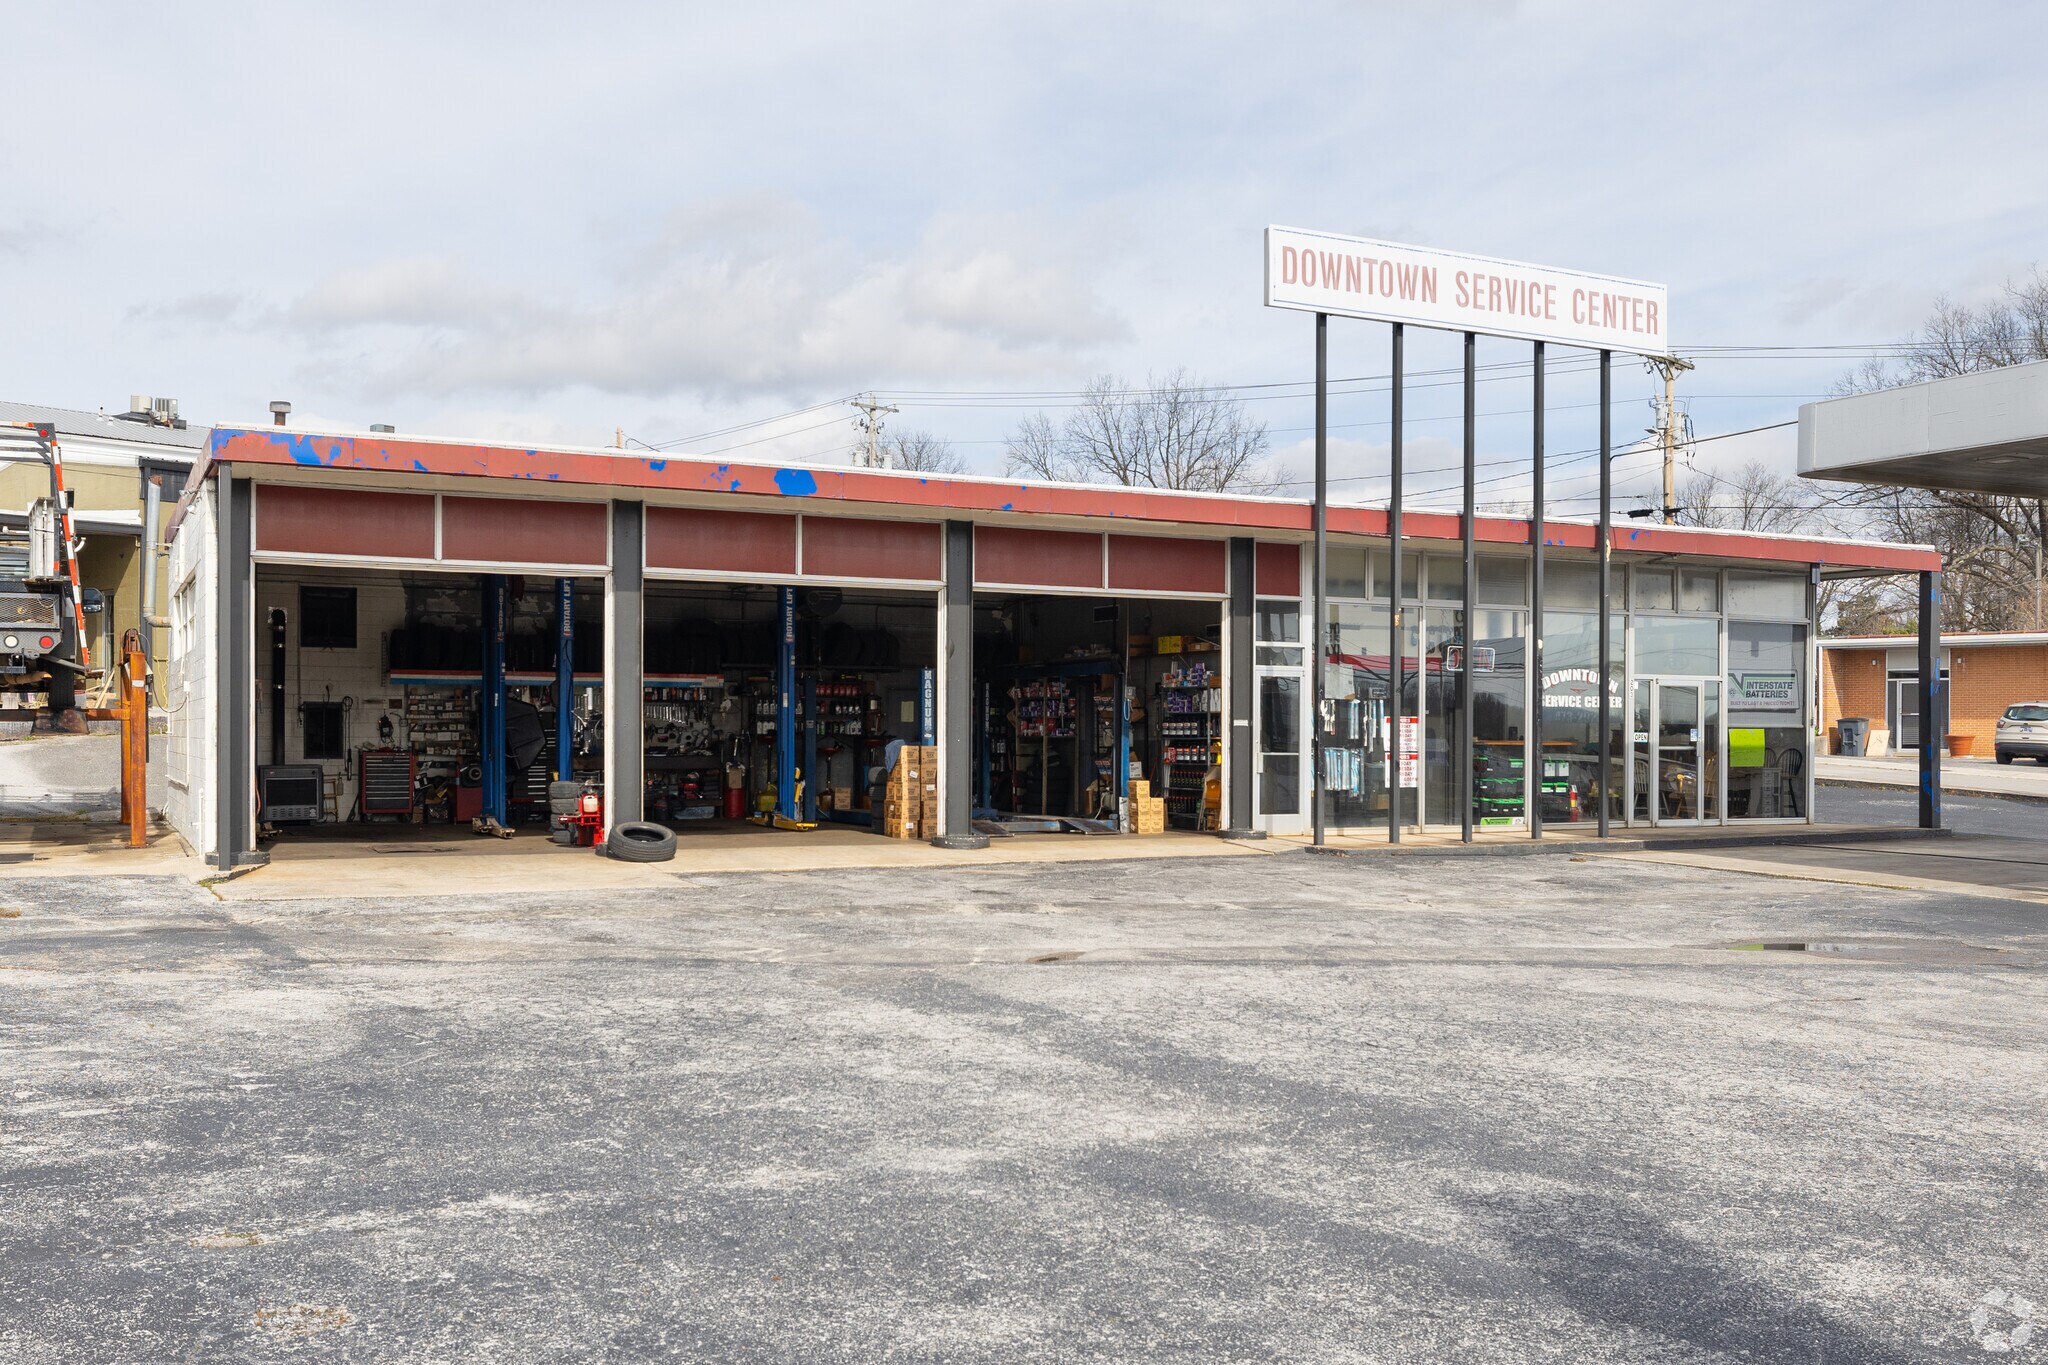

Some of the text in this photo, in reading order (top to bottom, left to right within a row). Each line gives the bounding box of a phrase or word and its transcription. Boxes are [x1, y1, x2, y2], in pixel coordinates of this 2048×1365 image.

[1282, 245, 1659, 335] DOWNTOWN SERVICE CENTER
[563, 578, 571, 632] ROTARY LIFT
[1542, 669, 1619, 694] DOWNTON
[1745, 690, 1789, 698] BATTERIES
[1746, 681, 1793, 690] INTERSTATE
[924, 670, 932, 728] MAGNUM
[1634, 733, 1647, 741] OPEN
